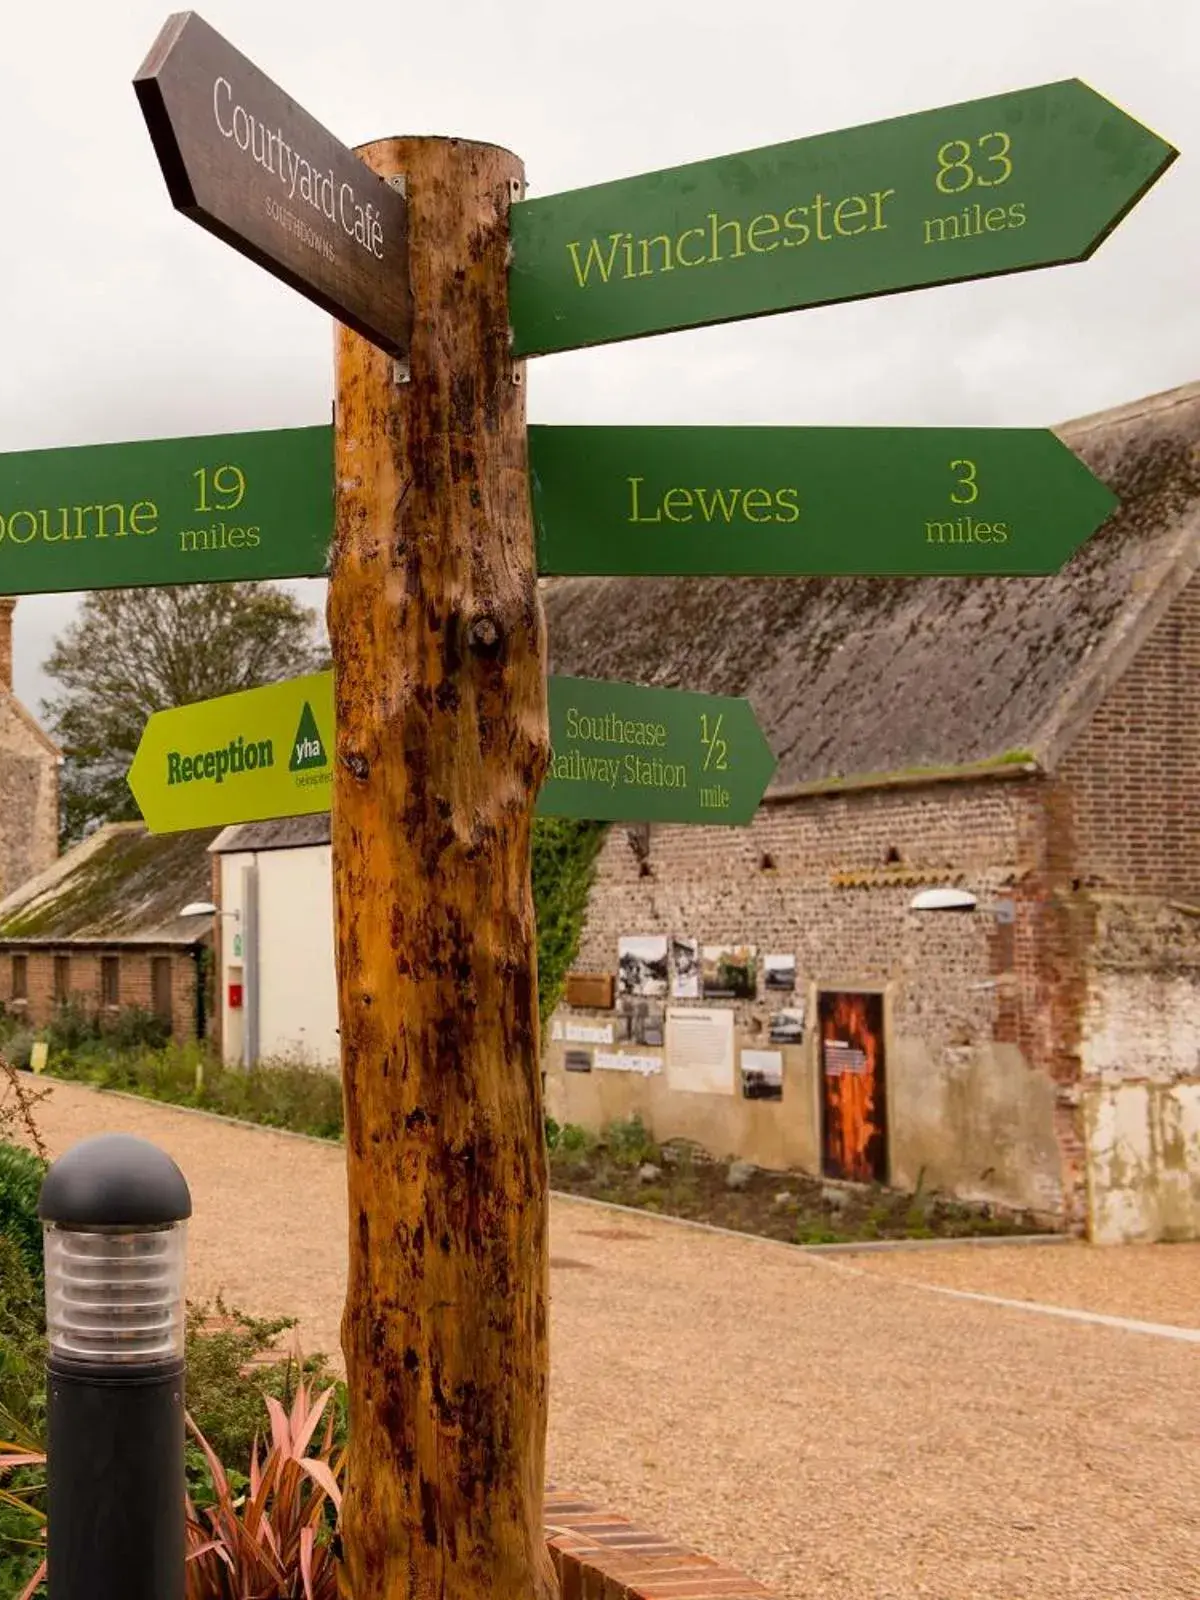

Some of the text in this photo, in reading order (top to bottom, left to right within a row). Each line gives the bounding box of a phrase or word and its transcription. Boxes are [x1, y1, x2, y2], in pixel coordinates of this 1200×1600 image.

[213, 76, 384, 260] Courtyard Café
[935, 131, 1013, 194] 83
[565, 187, 896, 288] Winchester
[923, 201, 1027, 245] miles
[191, 464, 247, 513] 19
[626, 477, 800, 523] Lewes
[948, 459, 979, 504] 3
[178, 522, 262, 552] miles
[924, 517, 1008, 544] miles
[566, 708, 667, 747] Southease
[166, 735, 275, 785] Reception
[295, 737, 320, 764] yha
[623, 754, 688, 788] Station
[699, 785, 730, 808] mile
